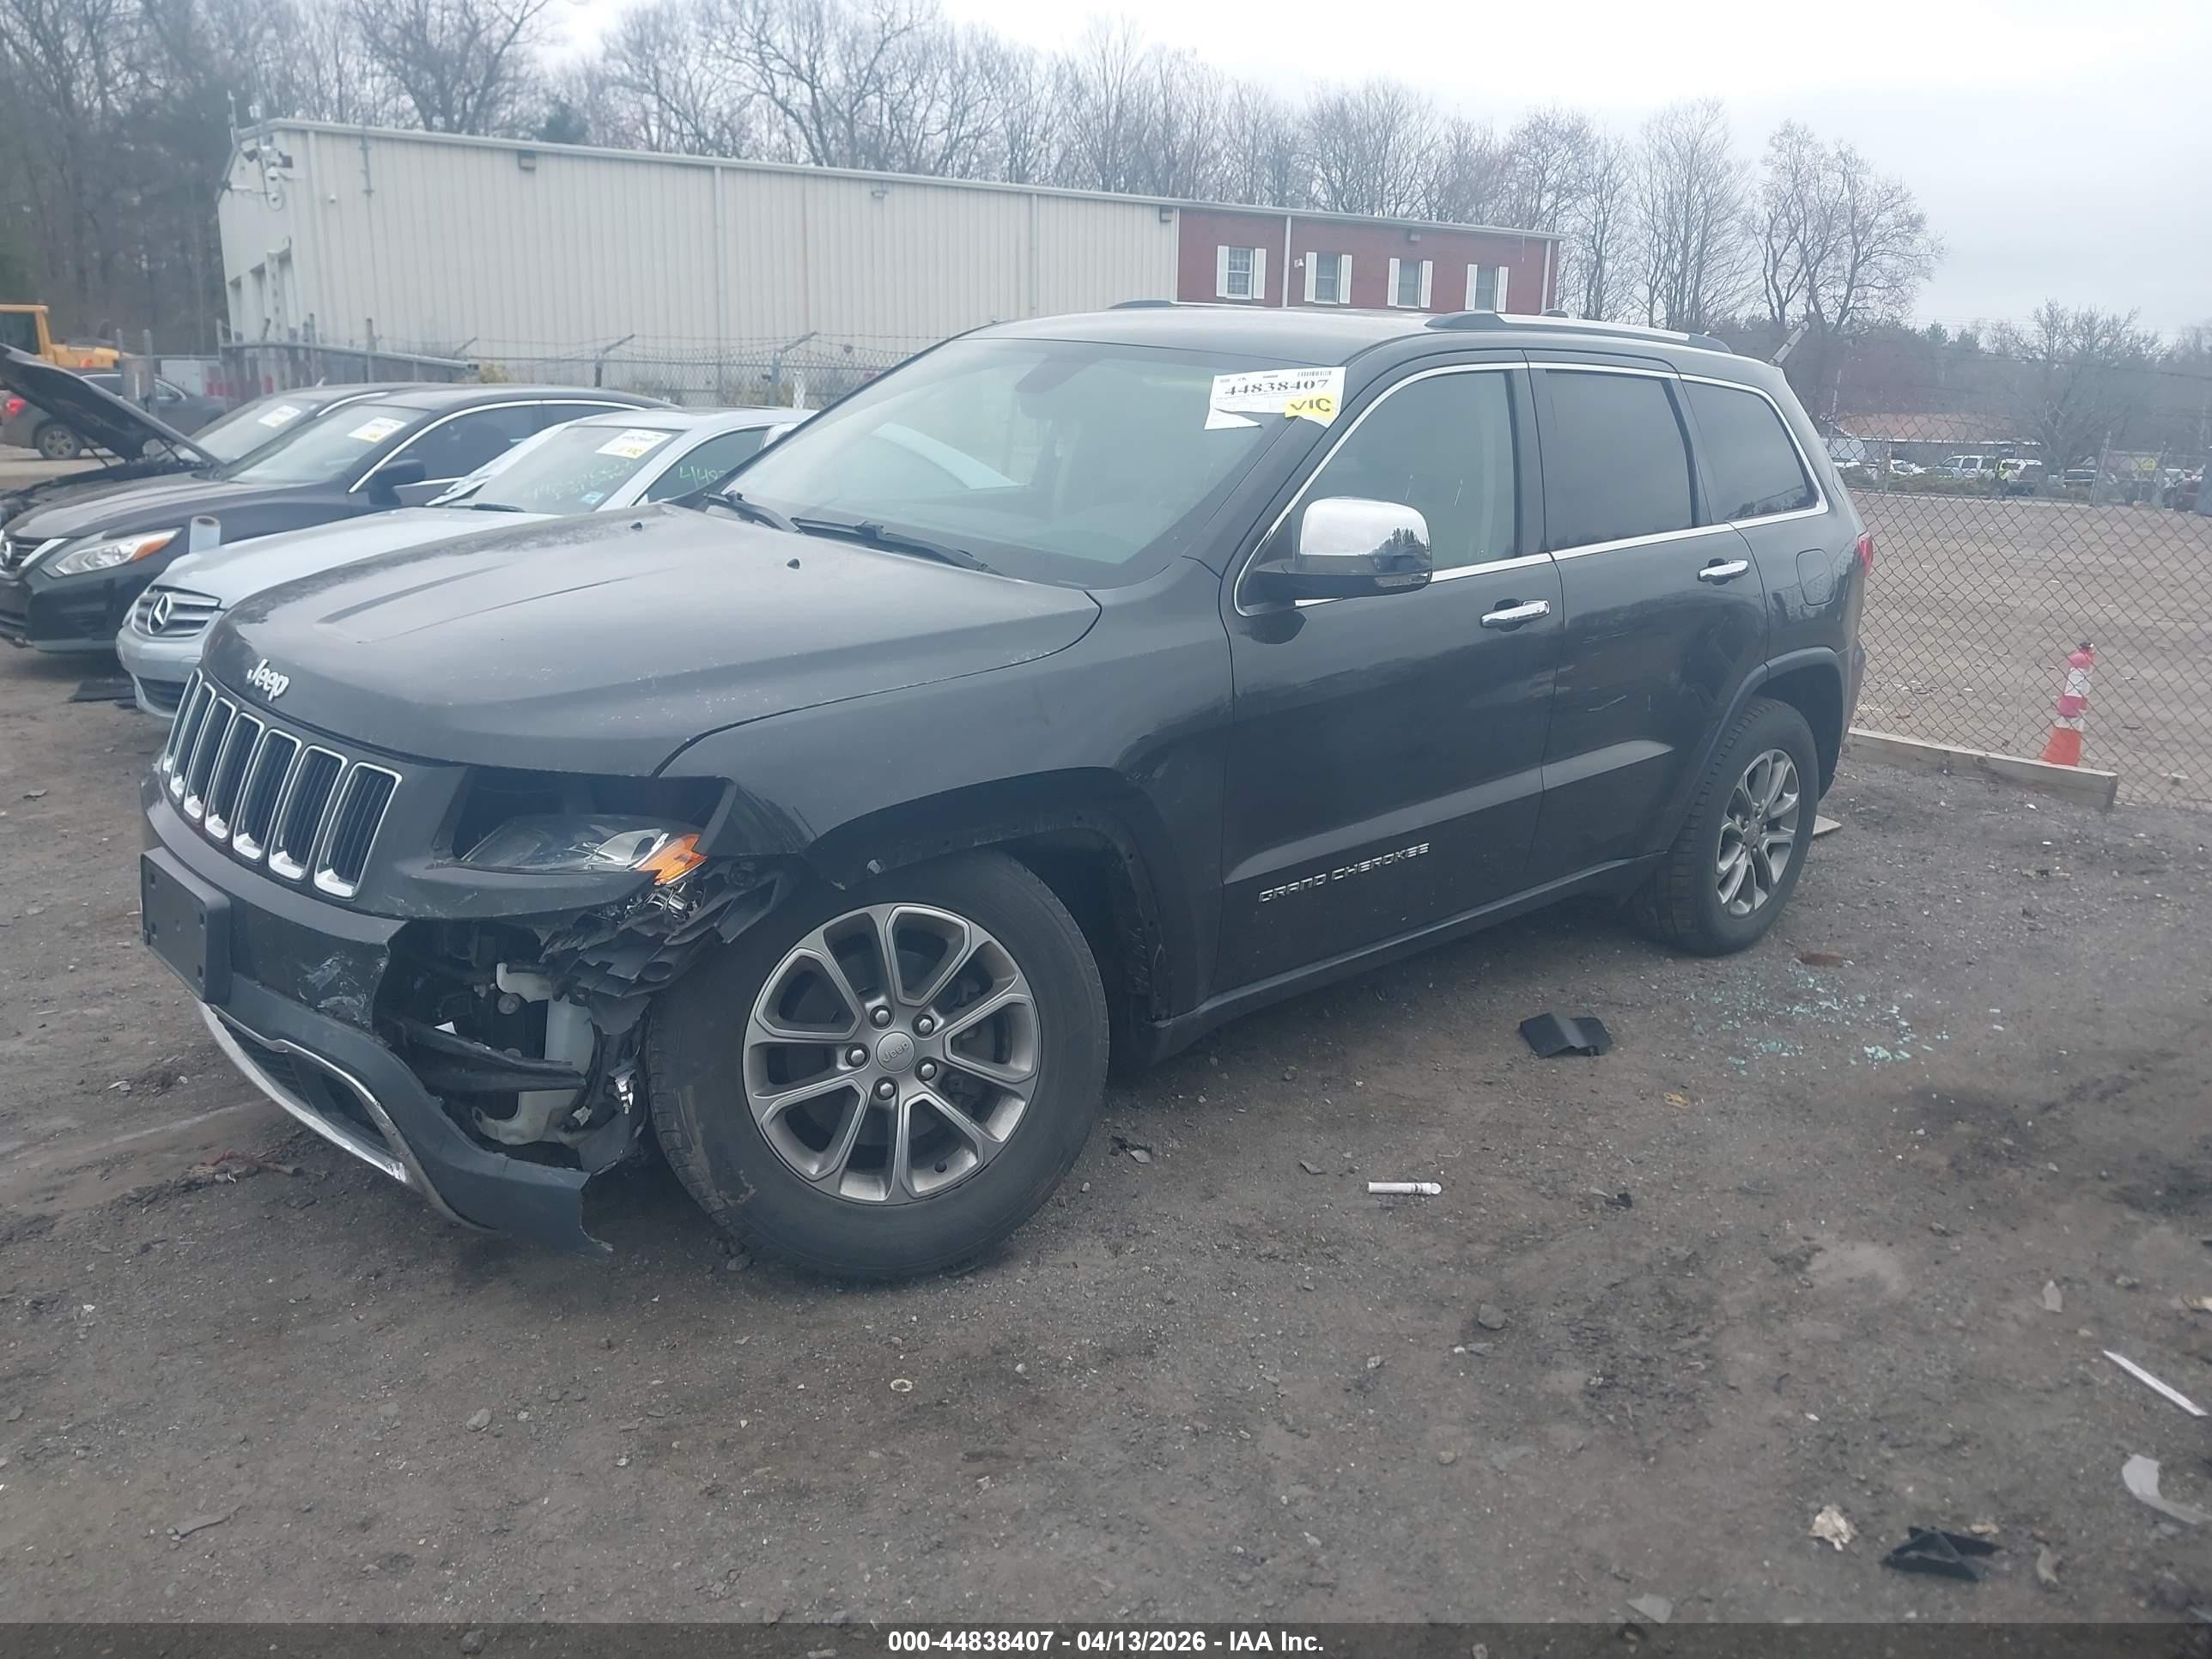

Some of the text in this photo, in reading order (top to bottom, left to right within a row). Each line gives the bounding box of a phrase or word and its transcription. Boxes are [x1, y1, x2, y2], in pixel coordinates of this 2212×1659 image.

[1224, 379, 1328, 395] 44838407
[246, 658, 289, 702] Jeep
[1258, 842, 1430, 902] GRAND CHEROKEE
[883, 1042, 908, 1062] Jeep
